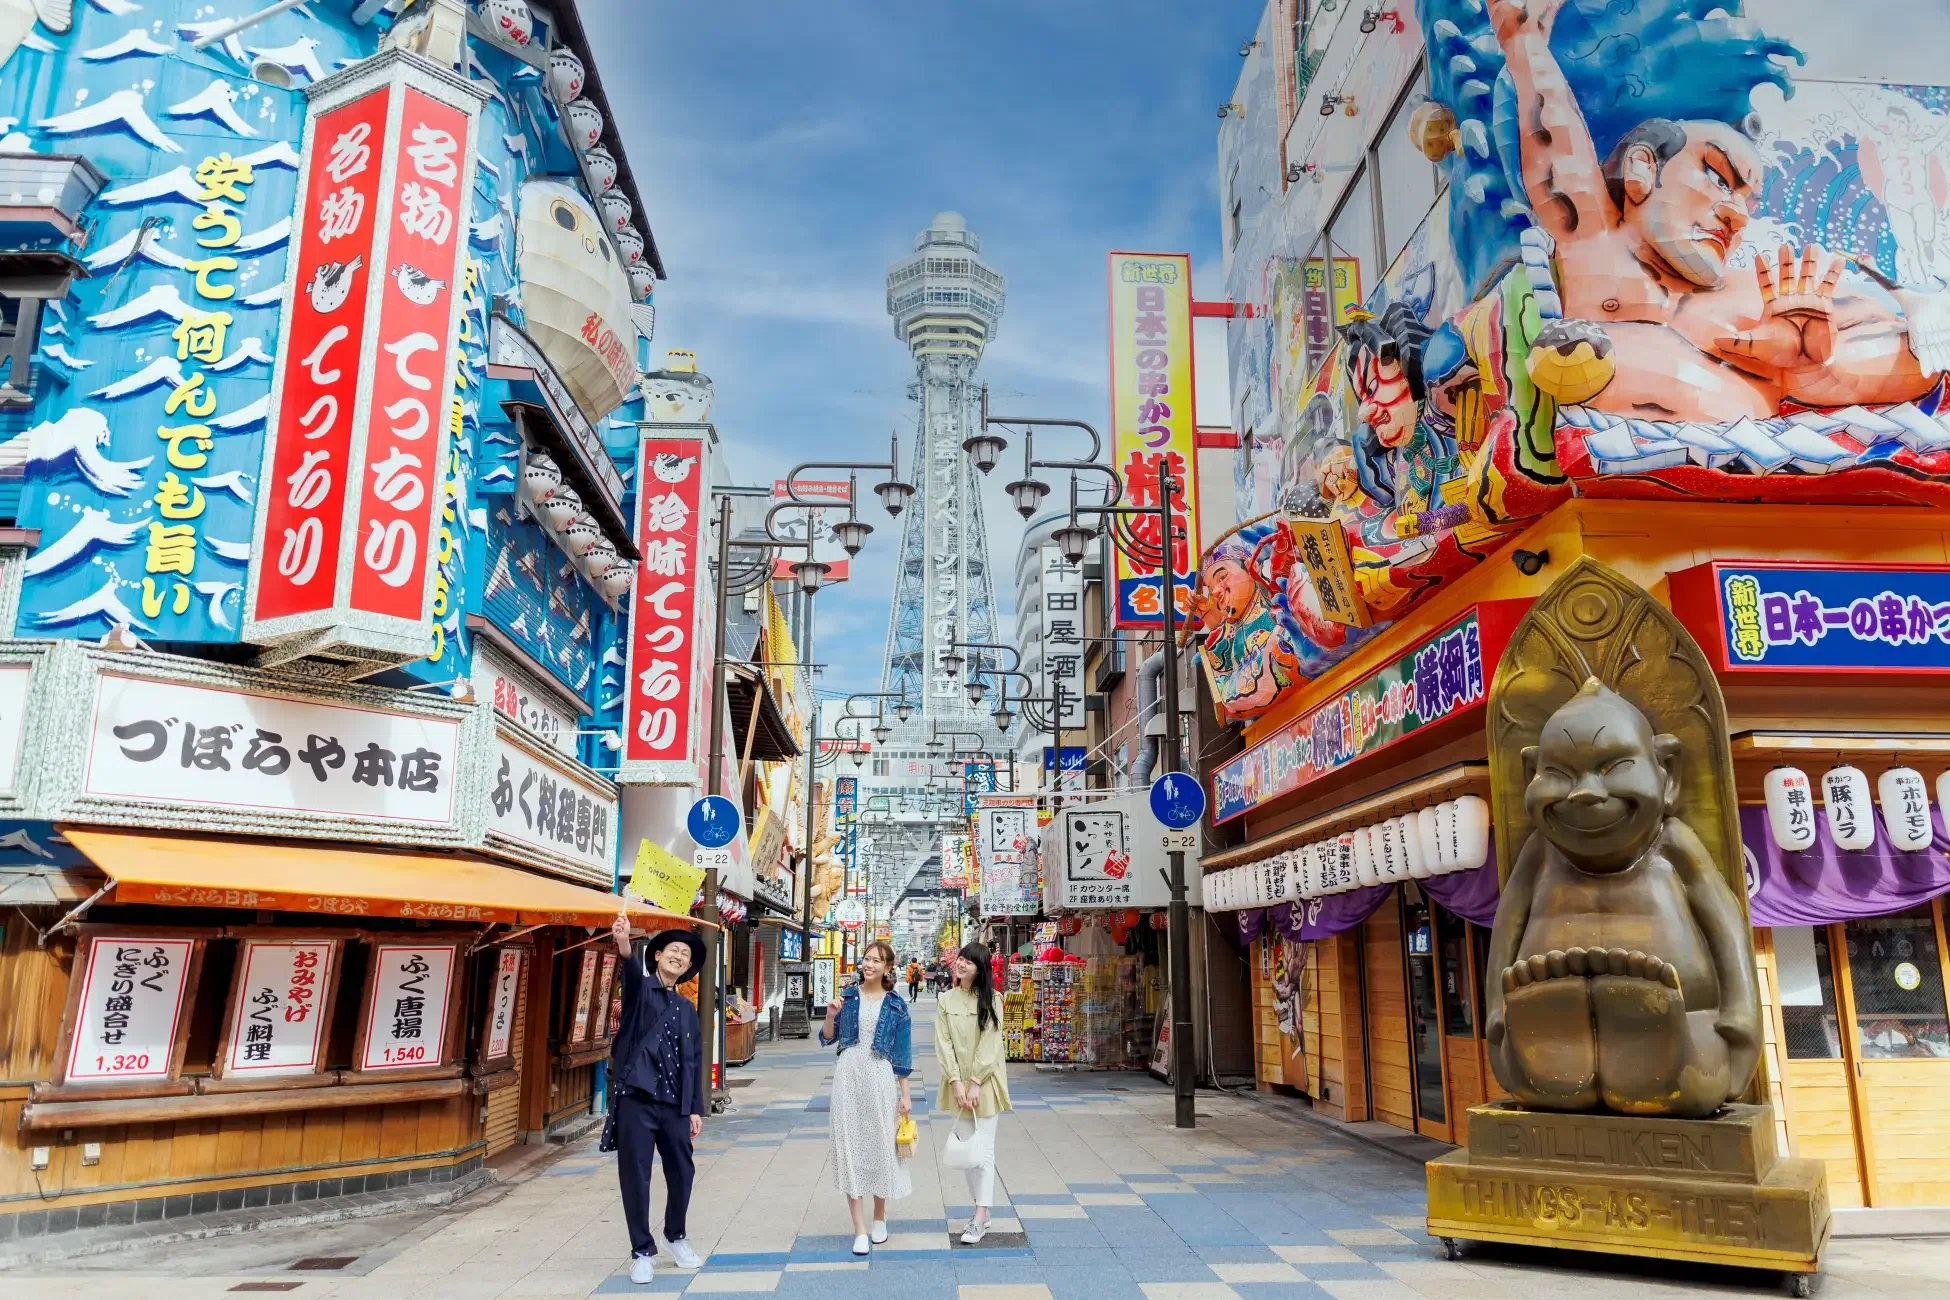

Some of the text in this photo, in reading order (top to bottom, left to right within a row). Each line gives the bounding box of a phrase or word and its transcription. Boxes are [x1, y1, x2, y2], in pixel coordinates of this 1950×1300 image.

[1121, 262, 1178, 284] 新世界
[139, 152, 254, 618] 安うて何んでも旨い
[1135, 284, 1172, 449] 日本一の串かつ
[277, 325, 349, 587] てっちり
[363, 332, 439, 588] てっちり
[1124, 451, 1188, 577] 横綱
[637, 493, 690, 751] 珍味てっちり
[1727, 577, 1765, 658] 新世界
[1414, 630, 1468, 723] 横綱
[1465, 622, 1484, 702] 名門
[495, 676, 558, 744] 名物 てっちり
[113, 716, 441, 793] づぼらや本店
[1826, 775, 1852, 785] 串かつ
[1895, 777, 1920, 785] 串かつ
[491, 753, 607, 859] ふぐ料理専門
[1787, 788, 1811, 841] 串かつ
[1830, 785, 1857, 839] 豚バラ
[1901, 787, 1926, 841] ホルモン
[155, 888, 276, 906] ふぐなら日本一
[400, 902, 495, 919] ふぐなら日本一
[983, 903, 1037, 913] 宴会予約受付中
[1070, 884, 1131, 894] 1F カウンター席
[1070, 895, 1131, 904] 2F 座敷あります
[100, 947, 142, 1045] にぎり盛合せ
[140, 946, 170, 992] ふぐ
[284, 951, 318, 1023] おみやげ
[391, 954, 430, 1040] ふぐ唐揚
[243, 987, 279, 1061] ふぐ料理
[383, 1046, 425, 1062] 1,540
[96, 1054, 149, 1072] 1,320
[1500, 1123, 1715, 1172] BILLIKEN
[1456, 1178, 1768, 1247] THINGS-AS-THEY
